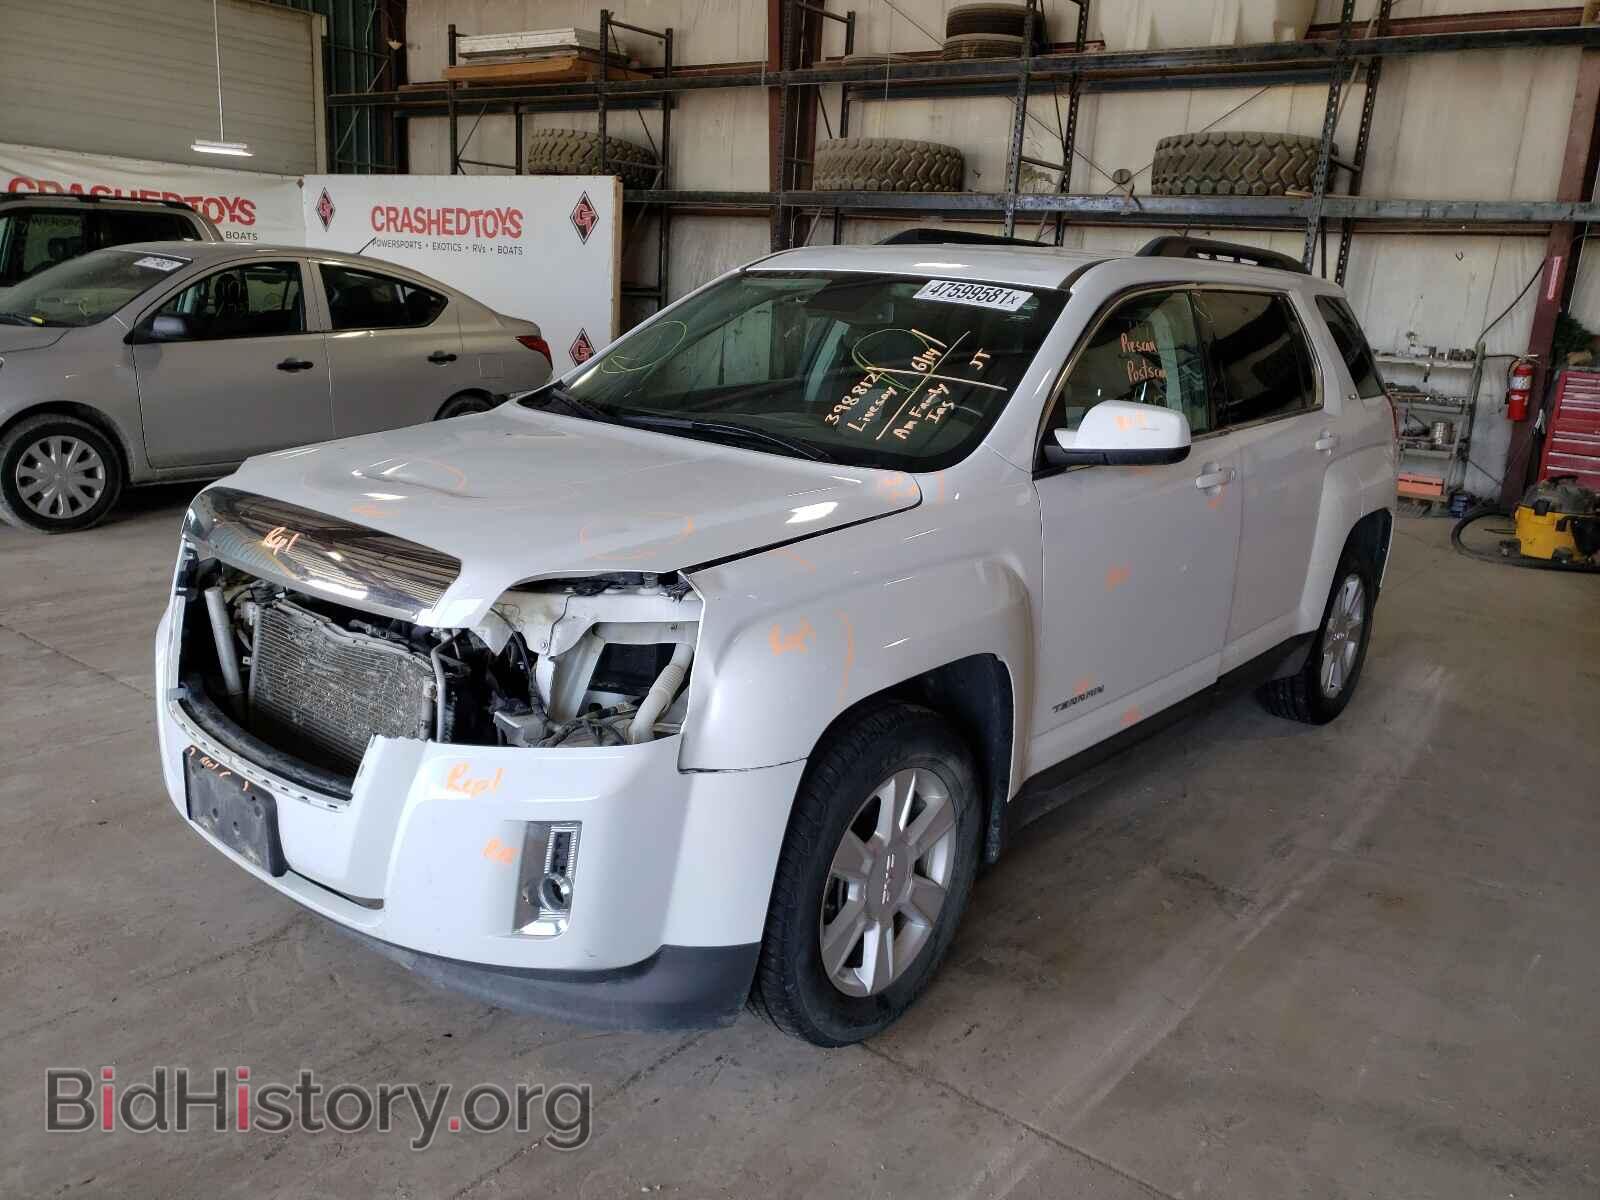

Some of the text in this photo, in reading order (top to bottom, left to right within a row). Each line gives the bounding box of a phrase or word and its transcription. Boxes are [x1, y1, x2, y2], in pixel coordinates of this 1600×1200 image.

[371, 205, 523, 239] CRASHEDTOYS
[225, 231, 258, 241] BOATS
[373, 239, 422, 250] POWERSPORTS
[432, 242, 462, 252] EXOTICS
[497, 246, 523, 256] BOATS
